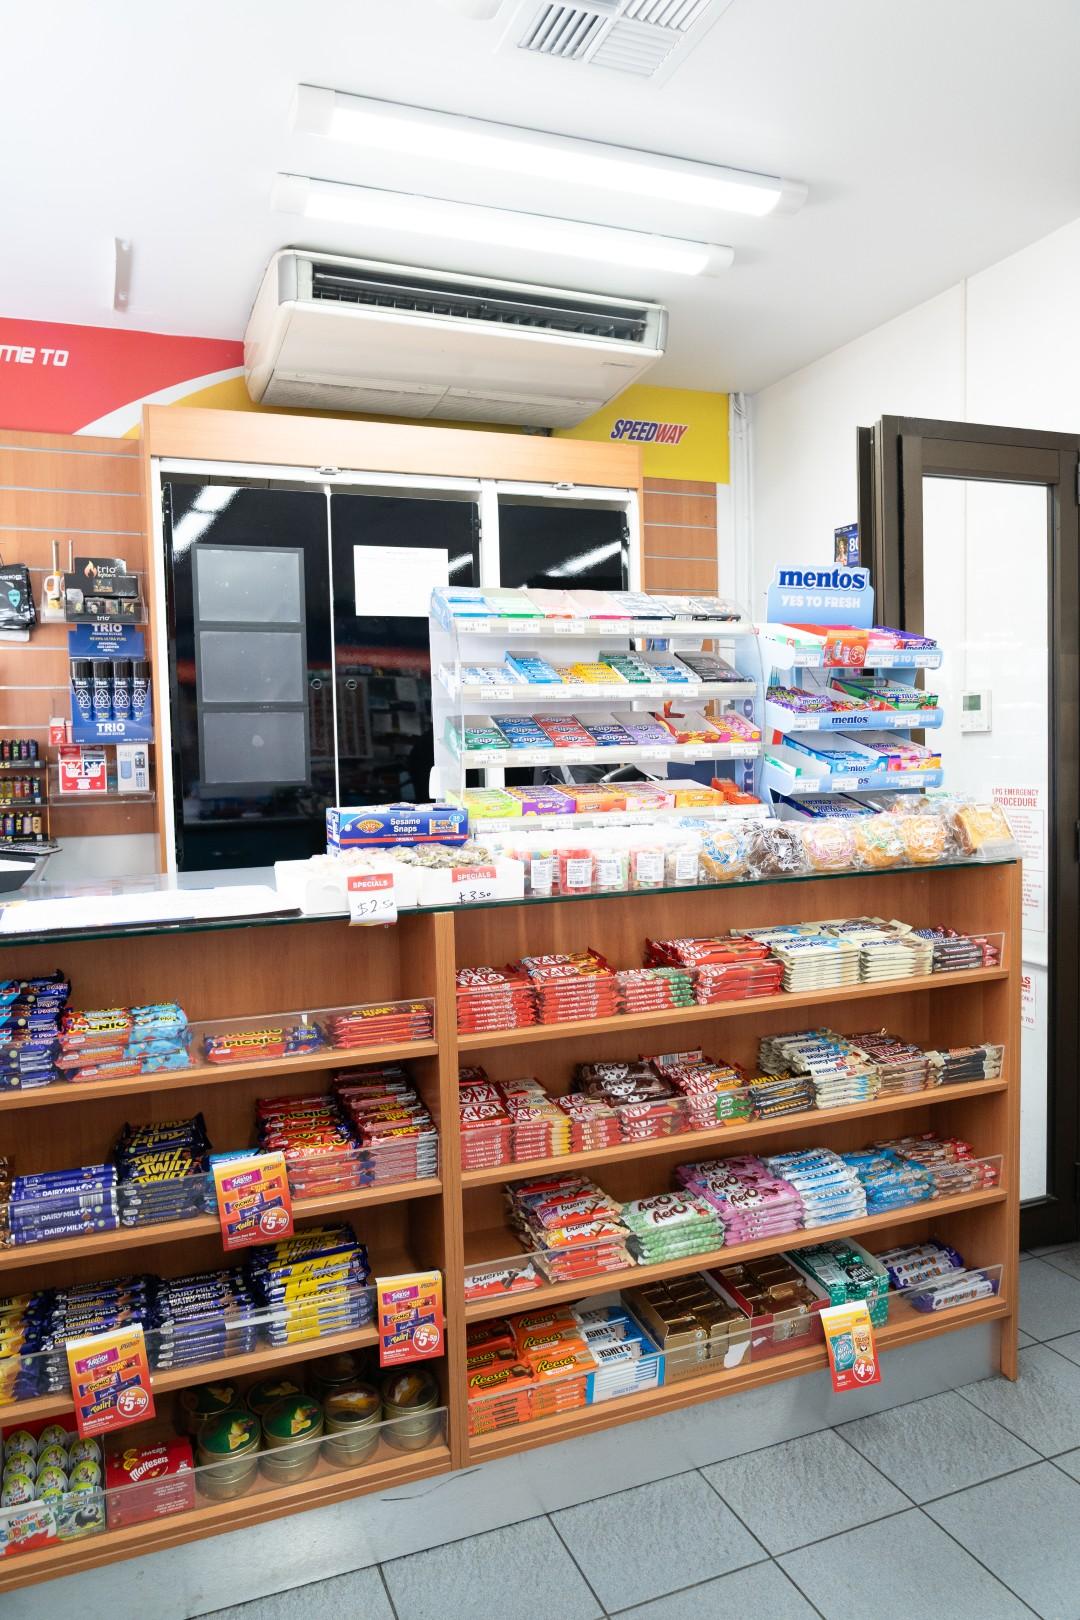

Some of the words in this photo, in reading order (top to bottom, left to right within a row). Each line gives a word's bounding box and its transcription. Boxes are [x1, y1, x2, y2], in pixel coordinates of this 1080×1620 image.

[41, 348, 69, 367] TO
[611, 419, 688, 444] SPEEDWAY
[778, 568, 865, 590] mentos
[781, 595, 804, 607] YES
[806, 595, 823, 607] TO
[825, 596, 861, 609] FRESH
[91, 624, 122, 633] TRIO
[831, 715, 869, 724] mentos
[96, 723, 126, 732] TRIO
[1004, 788, 1039, 796] EMERGENCY
[993, 797, 1038, 807] PROCEDURE
[393, 825, 418, 834] Snaps
[457, 871, 491, 881] SPECIALS
[352, 879, 388, 889] SPECIALS
[224, 1036, 282, 1048] PICNIC
[279, 1108, 330, 1120] PICNIC
[128, 1148, 184, 1164] Twirl
[137, 1158, 193, 1175] Twirl
[700, 1160, 728, 1174] Aero
[710, 1175, 739, 1192] Aero
[42, 1188, 63, 1197] DAIRY
[64, 1185, 81, 1194] MILK
[730, 1188, 760, 1206] Aero
[560, 1200, 587, 1212] bueno
[638, 1195, 672, 1212] Aero
[41, 1213, 62, 1221] DAIRY
[64, 1209, 81, 1218] MILK
[652, 1204, 688, 1223] Aero
[44, 1227, 65, 1236] DAIRY
[66, 1224, 84, 1232] MILK
[471, 1270, 505, 1283] bueno
[850, 1264, 872, 1277] Mint
[168, 1290, 194, 1300] DAIRY
[194, 1285, 217, 1294] MILK
[65, 1314, 93, 1323] DAIRY
[95, 1308, 118, 1318] MILK
[54, 1329, 83, 1339] DAIRY
[85, 1323, 108, 1333] MILK
[524, 1331, 563, 1348] Reese's
[466, 1351, 496, 1364] eese's
[537, 1355, 577, 1372] Reese's
[470, 1369, 510, 1388] Reese's
[90, 1400, 112, 1414] Twirl
[120, 1396, 147, 1412] $5.50
[129, 1456, 169, 1481] Maltesers
[8, 1511, 39, 1528] kinder
